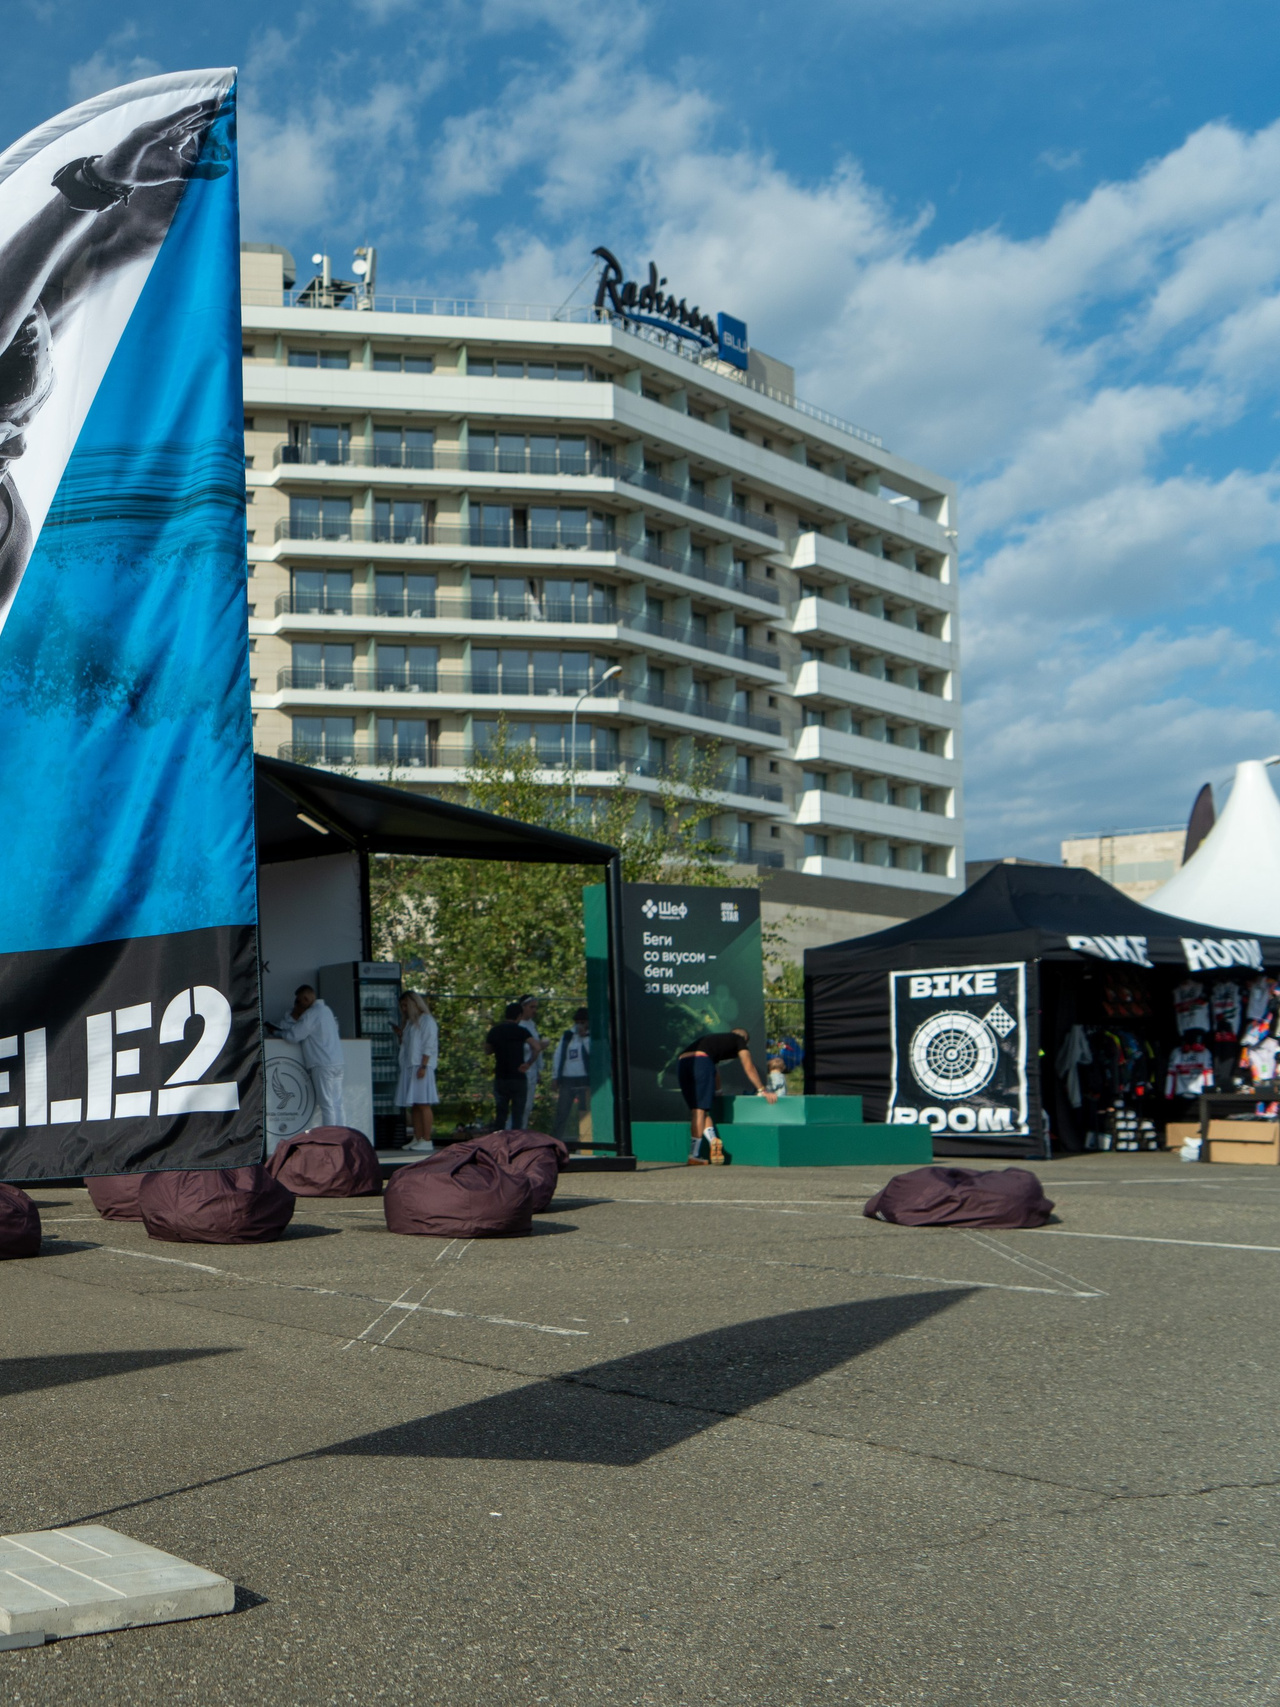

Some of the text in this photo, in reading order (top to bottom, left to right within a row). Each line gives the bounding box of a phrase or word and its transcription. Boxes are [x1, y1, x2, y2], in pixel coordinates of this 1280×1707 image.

[592, 246, 719, 343] Radisson
[723, 331, 746, 353] BLU
[658, 901, 688, 919] Шеф
[643, 932, 673, 946] Беги
[643, 951, 660, 962] со
[662, 952, 706, 966] вкусом
[644, 964, 674, 978] беги
[644, 981, 710, 997] за вкусом!
[909, 971, 998, 999] BIKE
